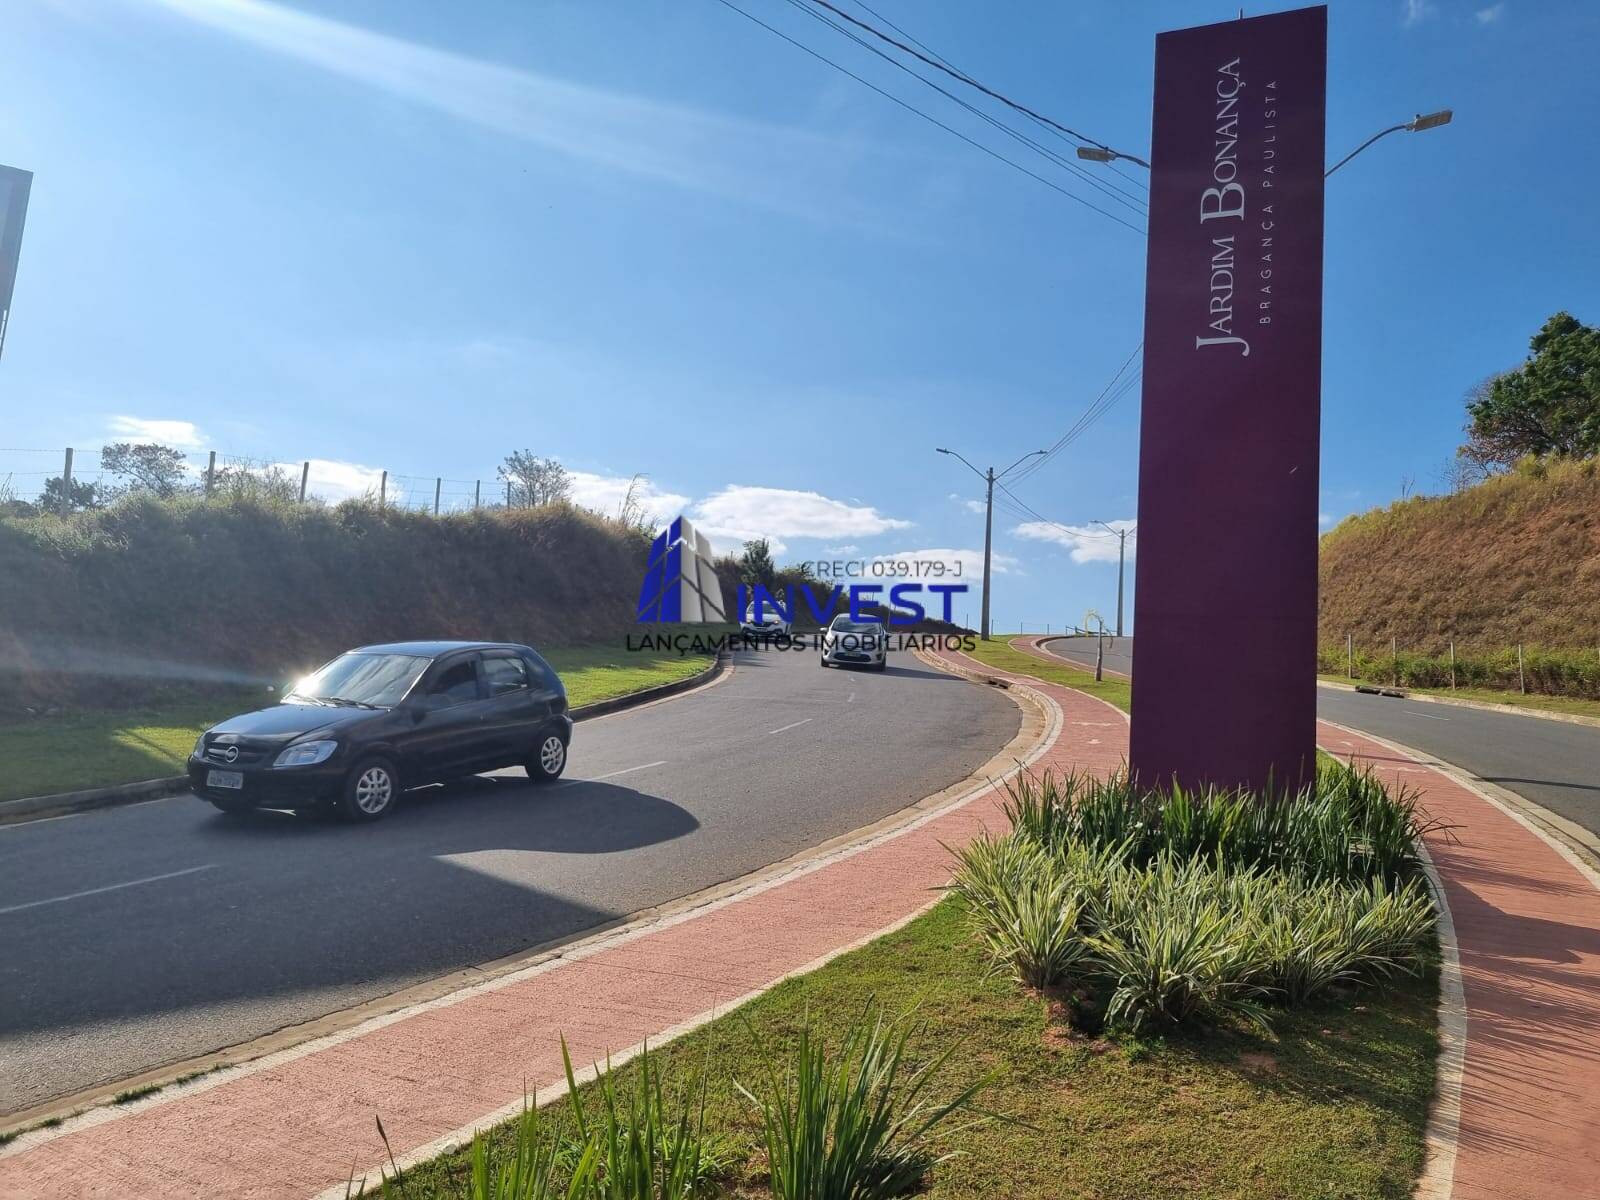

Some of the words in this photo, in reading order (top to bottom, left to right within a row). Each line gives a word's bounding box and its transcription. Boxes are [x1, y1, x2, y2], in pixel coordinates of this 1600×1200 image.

[1200, 57, 1246, 224] BONANÇA
[1262, 80, 1279, 189] PAULISTA
[1195, 236, 1250, 357] JARDIM
[1259, 204, 1275, 325] BRAGANÇA
